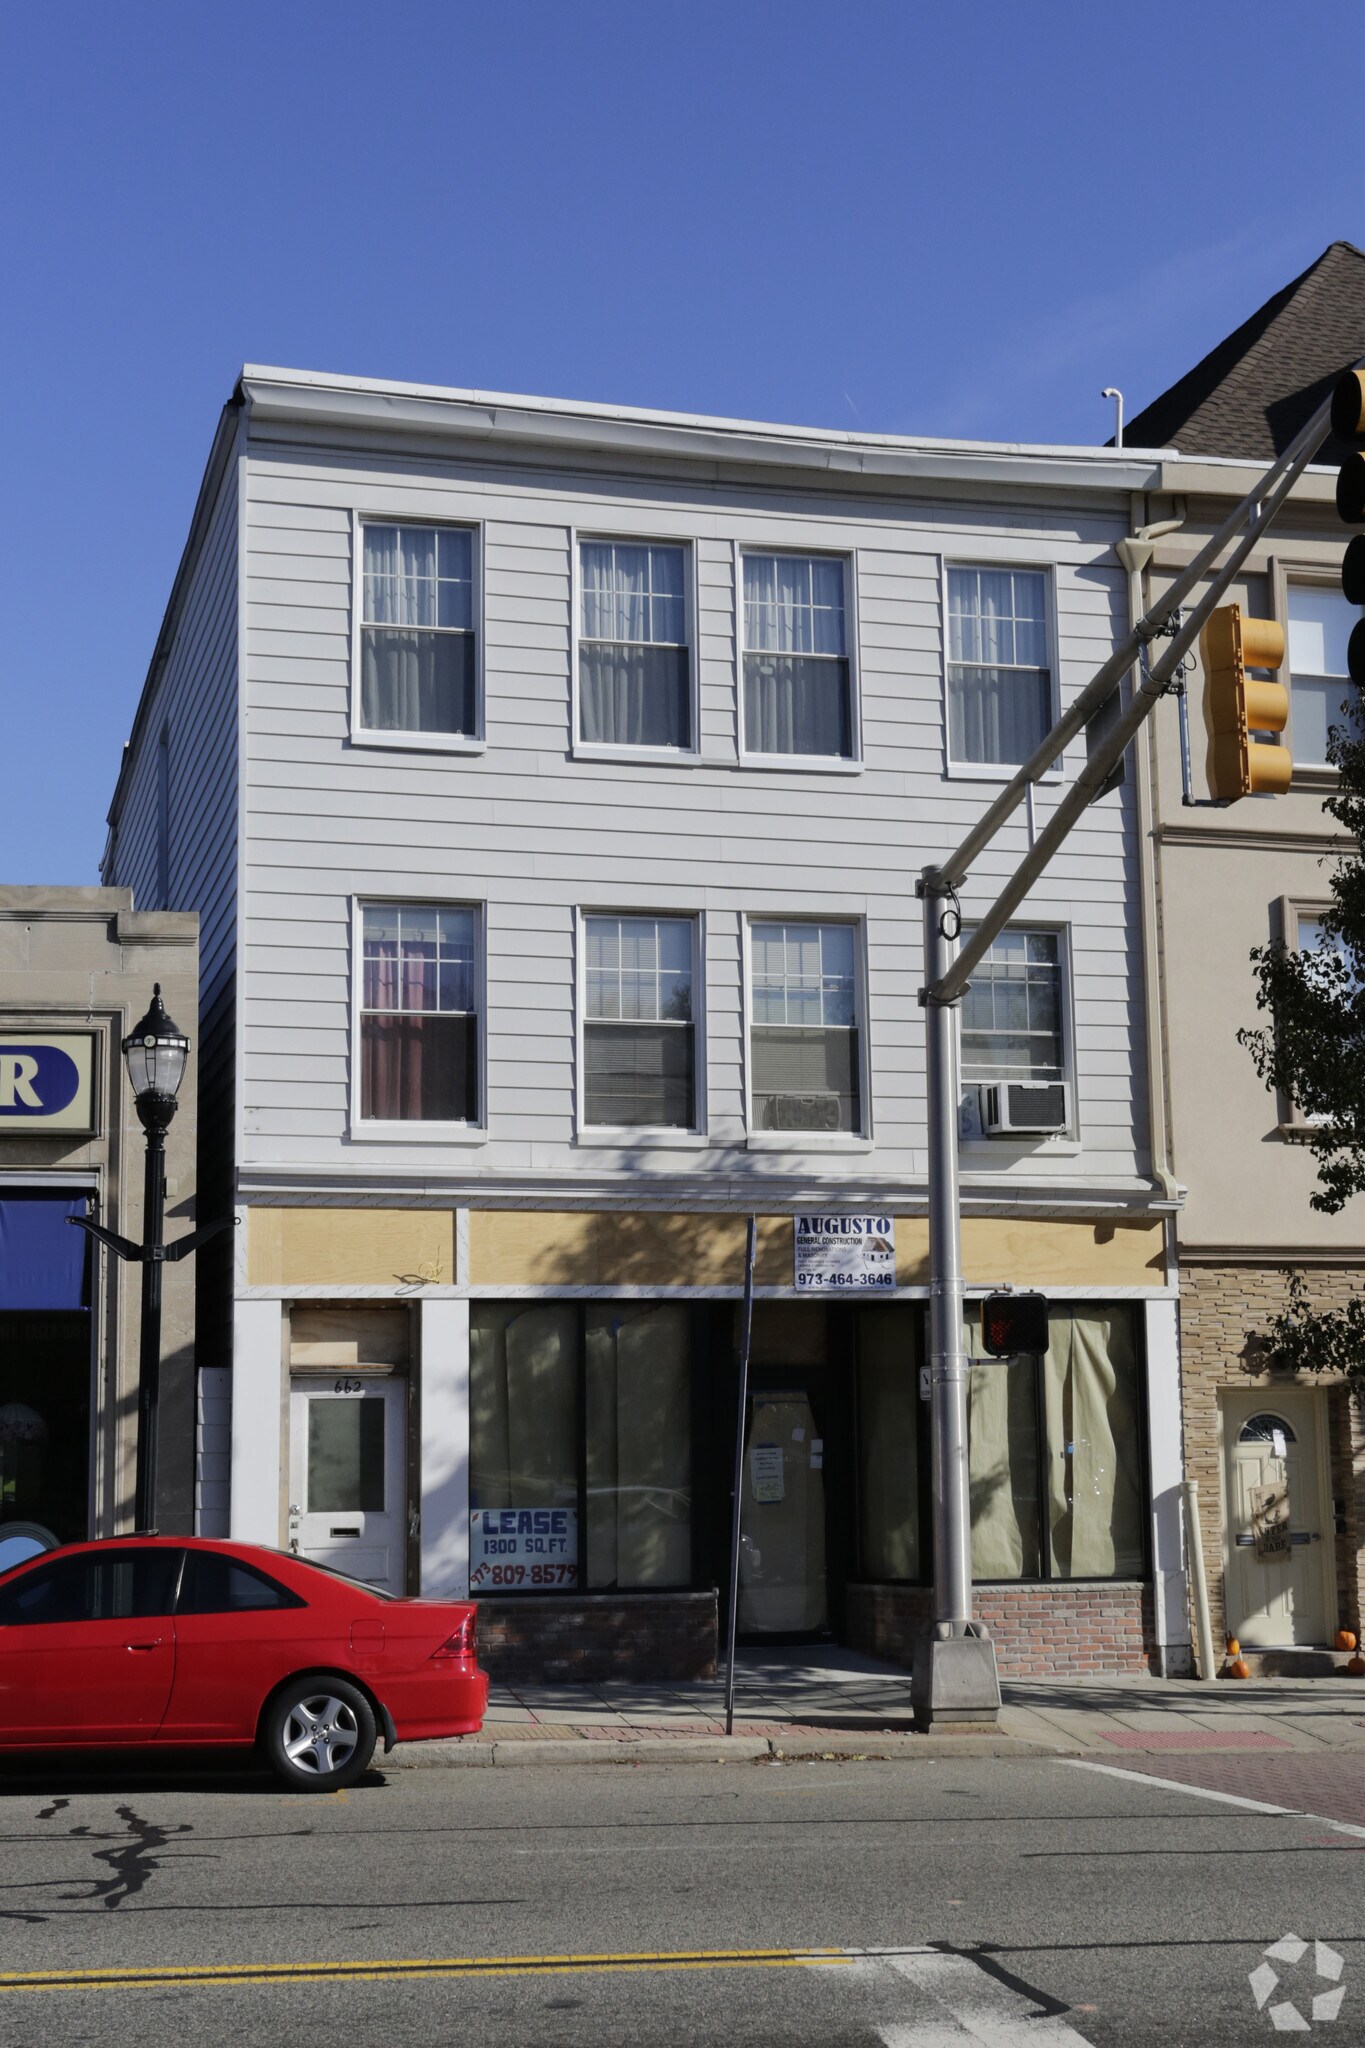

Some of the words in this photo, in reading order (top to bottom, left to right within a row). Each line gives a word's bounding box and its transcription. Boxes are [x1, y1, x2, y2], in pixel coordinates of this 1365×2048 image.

[798, 1217, 891, 1235] AUGUSTO
[797, 1236, 821, 1245] GENERAL
[822, 1236, 862, 1246] CONSTRUCTION
[798, 1273, 892, 1285] 973-464-3646
[334, 1380, 362, 1394] 662
[482, 1511, 568, 1535] LEASE
[484, 1539, 517, 1555] 1300
[1263, 1540, 1287, 1553] DARE
[470, 1562, 491, 1585] 973
[491, 1564, 577, 1585] 809-8579
